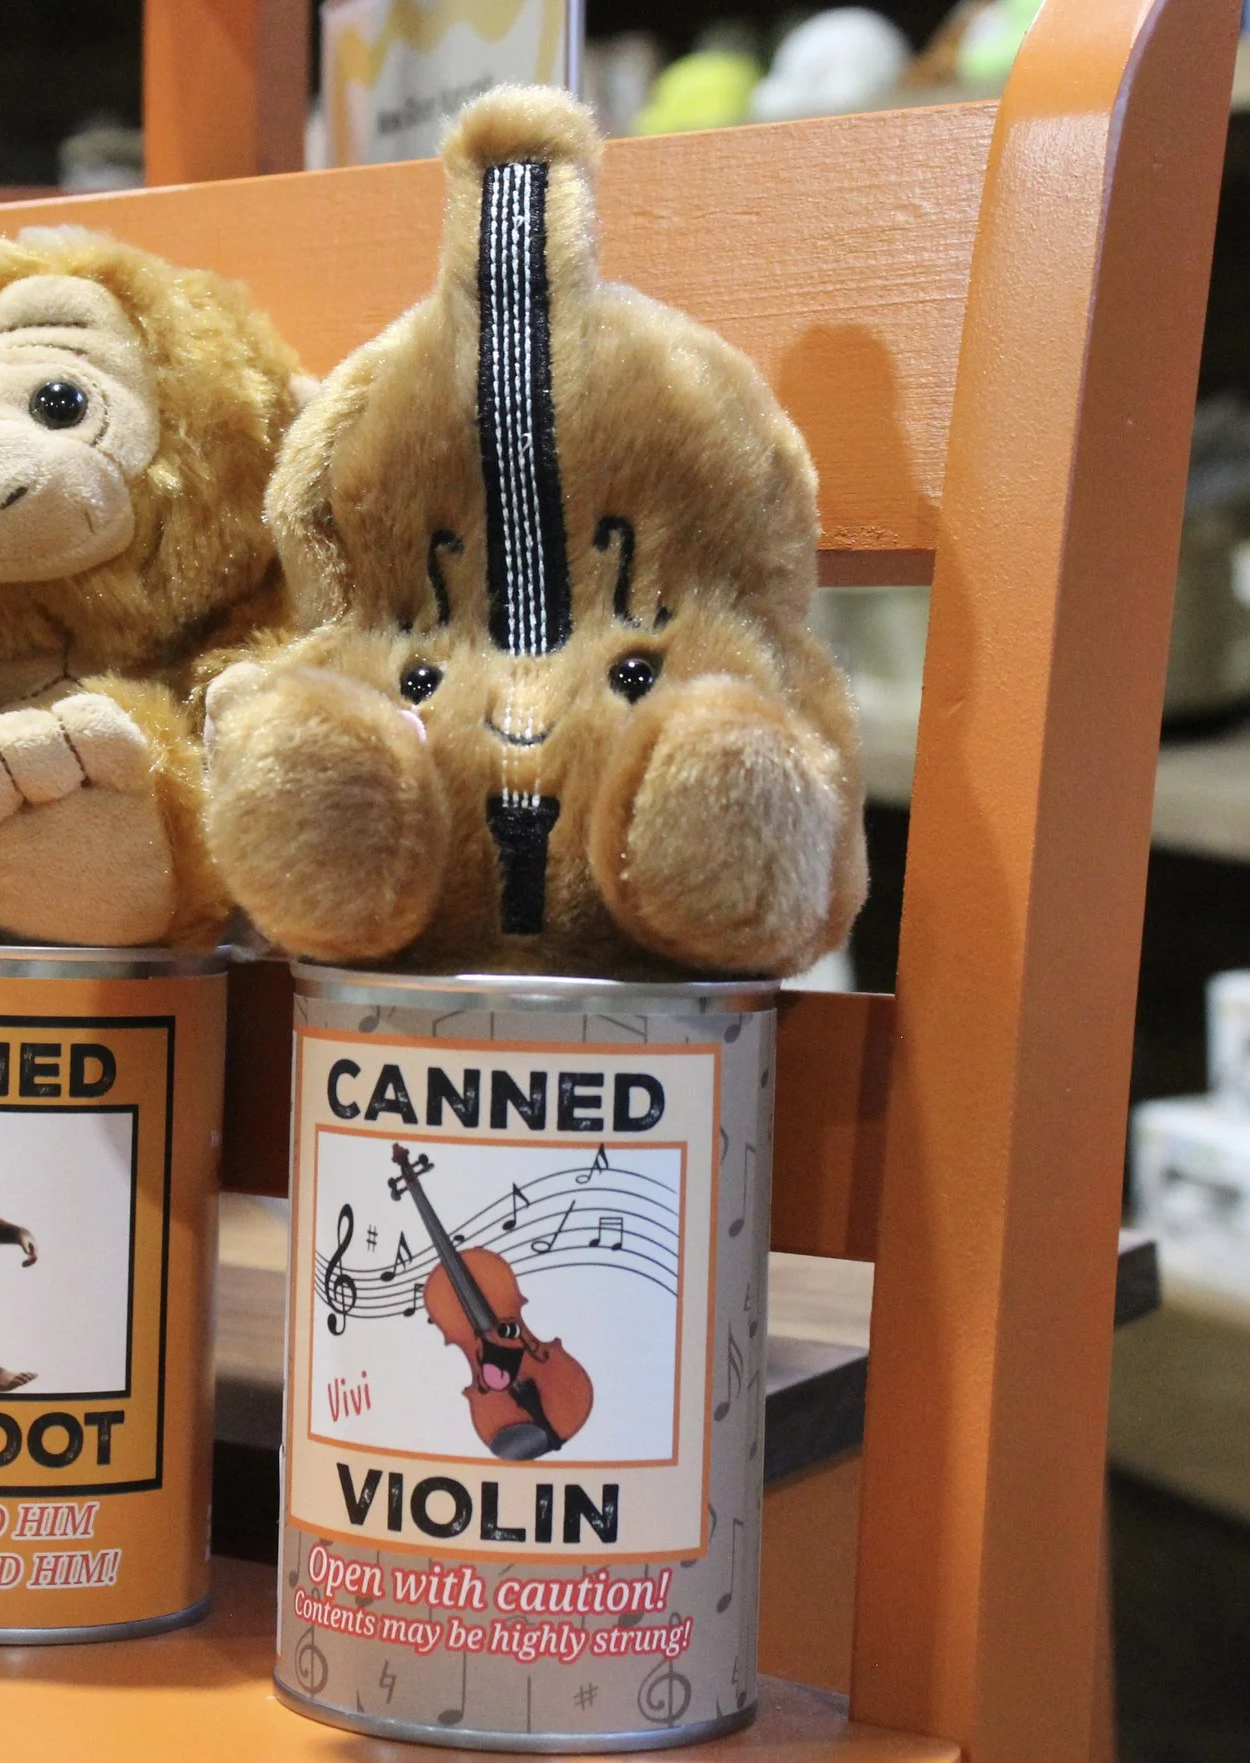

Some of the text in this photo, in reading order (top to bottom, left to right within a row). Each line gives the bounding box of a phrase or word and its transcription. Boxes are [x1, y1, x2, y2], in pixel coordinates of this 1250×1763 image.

[327, 1058, 666, 1133] CANNED
[327, 1370, 372, 1423] Vivi
[14, 1502, 97, 1539] HIM
[336, 1462, 620, 1544] VIOLIN
[28, 1550, 121, 1587] HIM!
[308, 1545, 673, 1614] Open with caution!
[293, 1589, 693, 1662] Contents may be highly strung!
